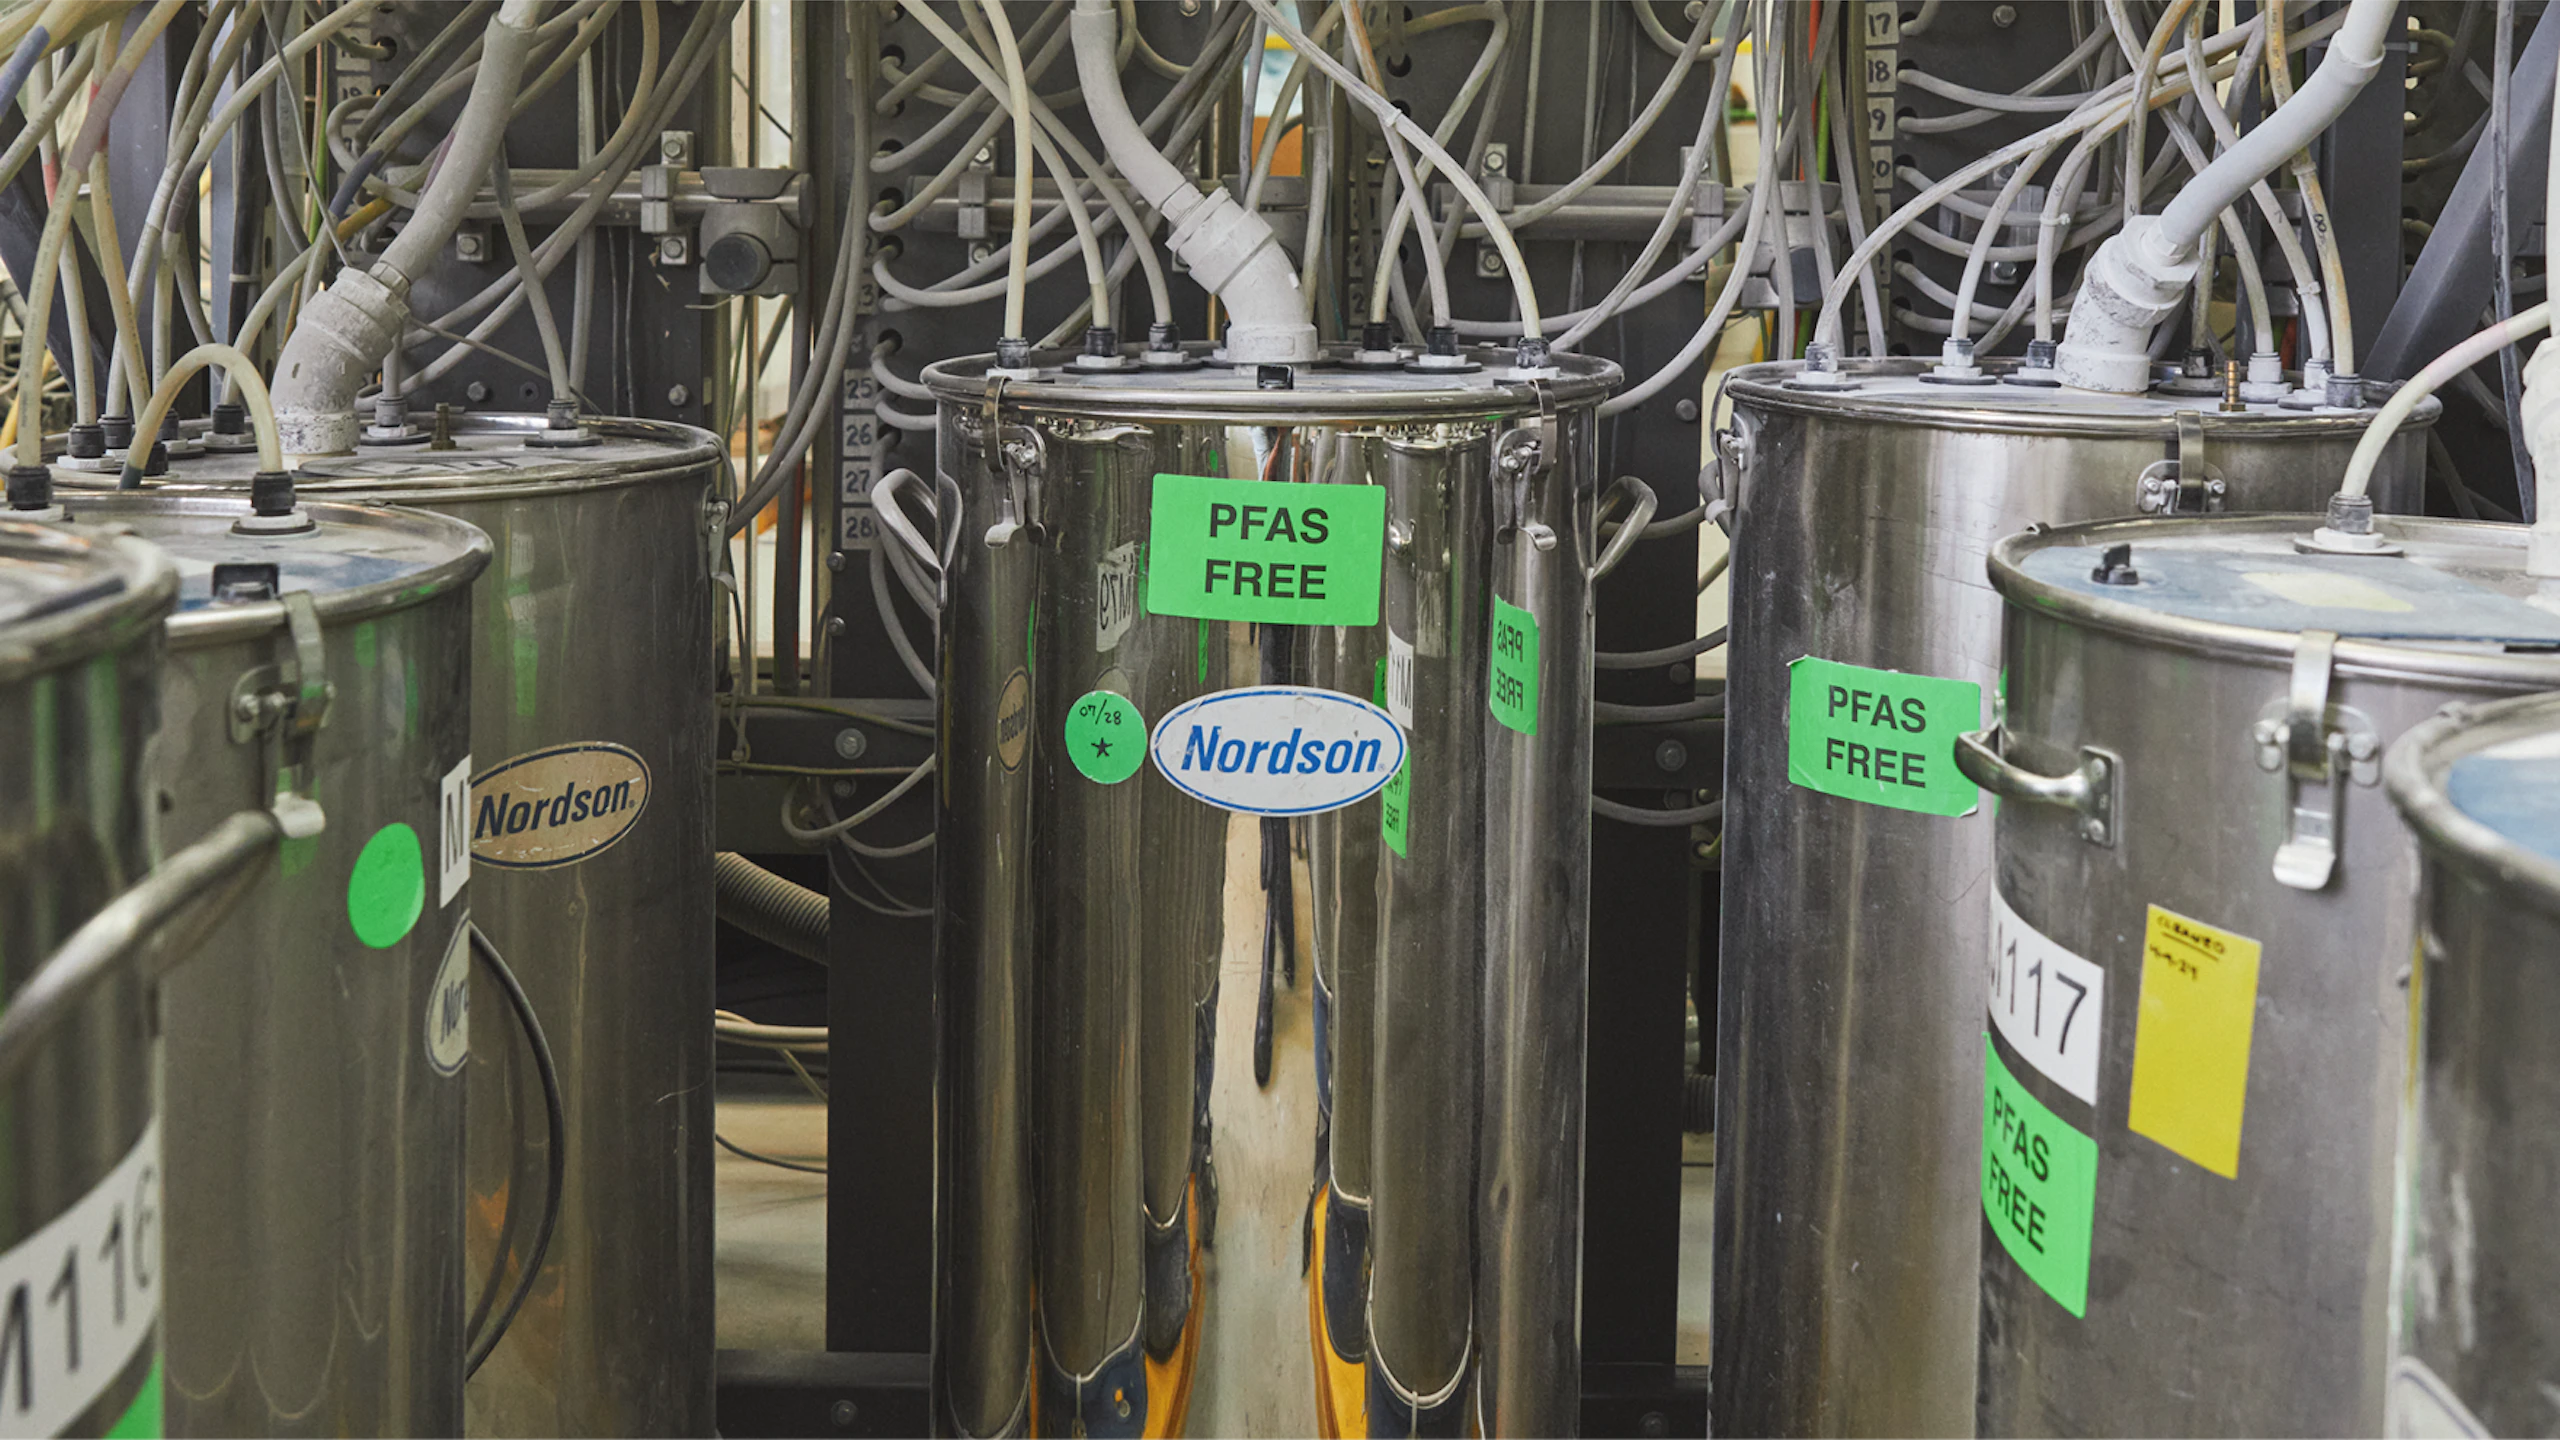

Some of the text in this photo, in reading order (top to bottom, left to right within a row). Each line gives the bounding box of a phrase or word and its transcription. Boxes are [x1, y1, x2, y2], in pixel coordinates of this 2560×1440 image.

[1868, 12, 1891, 37] 17
[1868, 59, 1890, 83] 18
[846, 379, 873, 400] 25
[846, 423, 873, 446] 26
[845, 470, 870, 493] 27
[846, 516, 873, 539] 28
[1209, 503, 1329, 544] PFAS
[1204, 559, 1327, 599] FREE
[1079, 699, 1122, 725] 07/28
[1828, 684, 1926, 733] PFAS
[1181, 725, 1382, 775] Nordson
[1826, 737, 1926, 788] FREE
[474, 780, 632, 839] Nordson
[1992, 1084, 2050, 1183] PFAS
[1989, 1150, 2046, 1255] FREE
